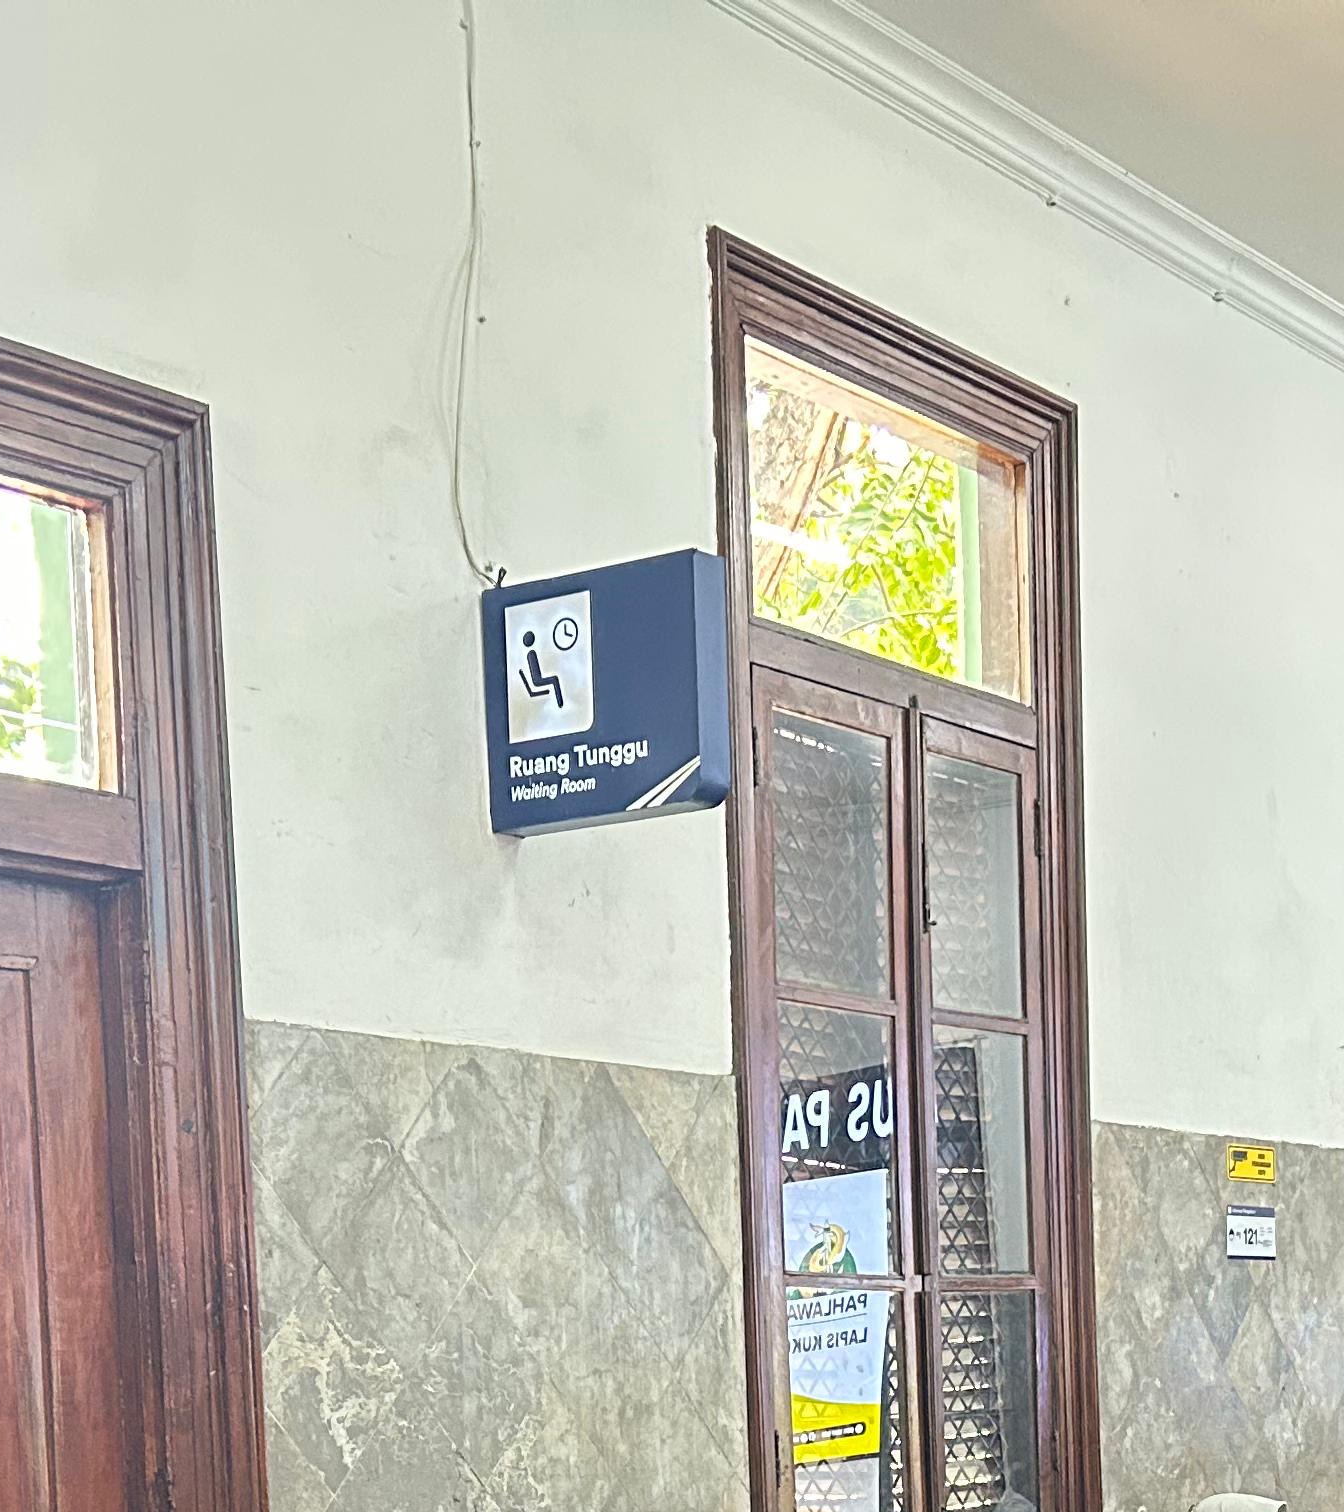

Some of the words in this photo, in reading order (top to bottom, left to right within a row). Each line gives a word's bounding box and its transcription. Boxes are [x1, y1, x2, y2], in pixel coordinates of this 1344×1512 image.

[509, 753, 570, 778] Ruang
[573, 739, 648, 768] Tunggu
[511, 782, 558, 802] Waiting
[560, 777, 596, 794] Room
